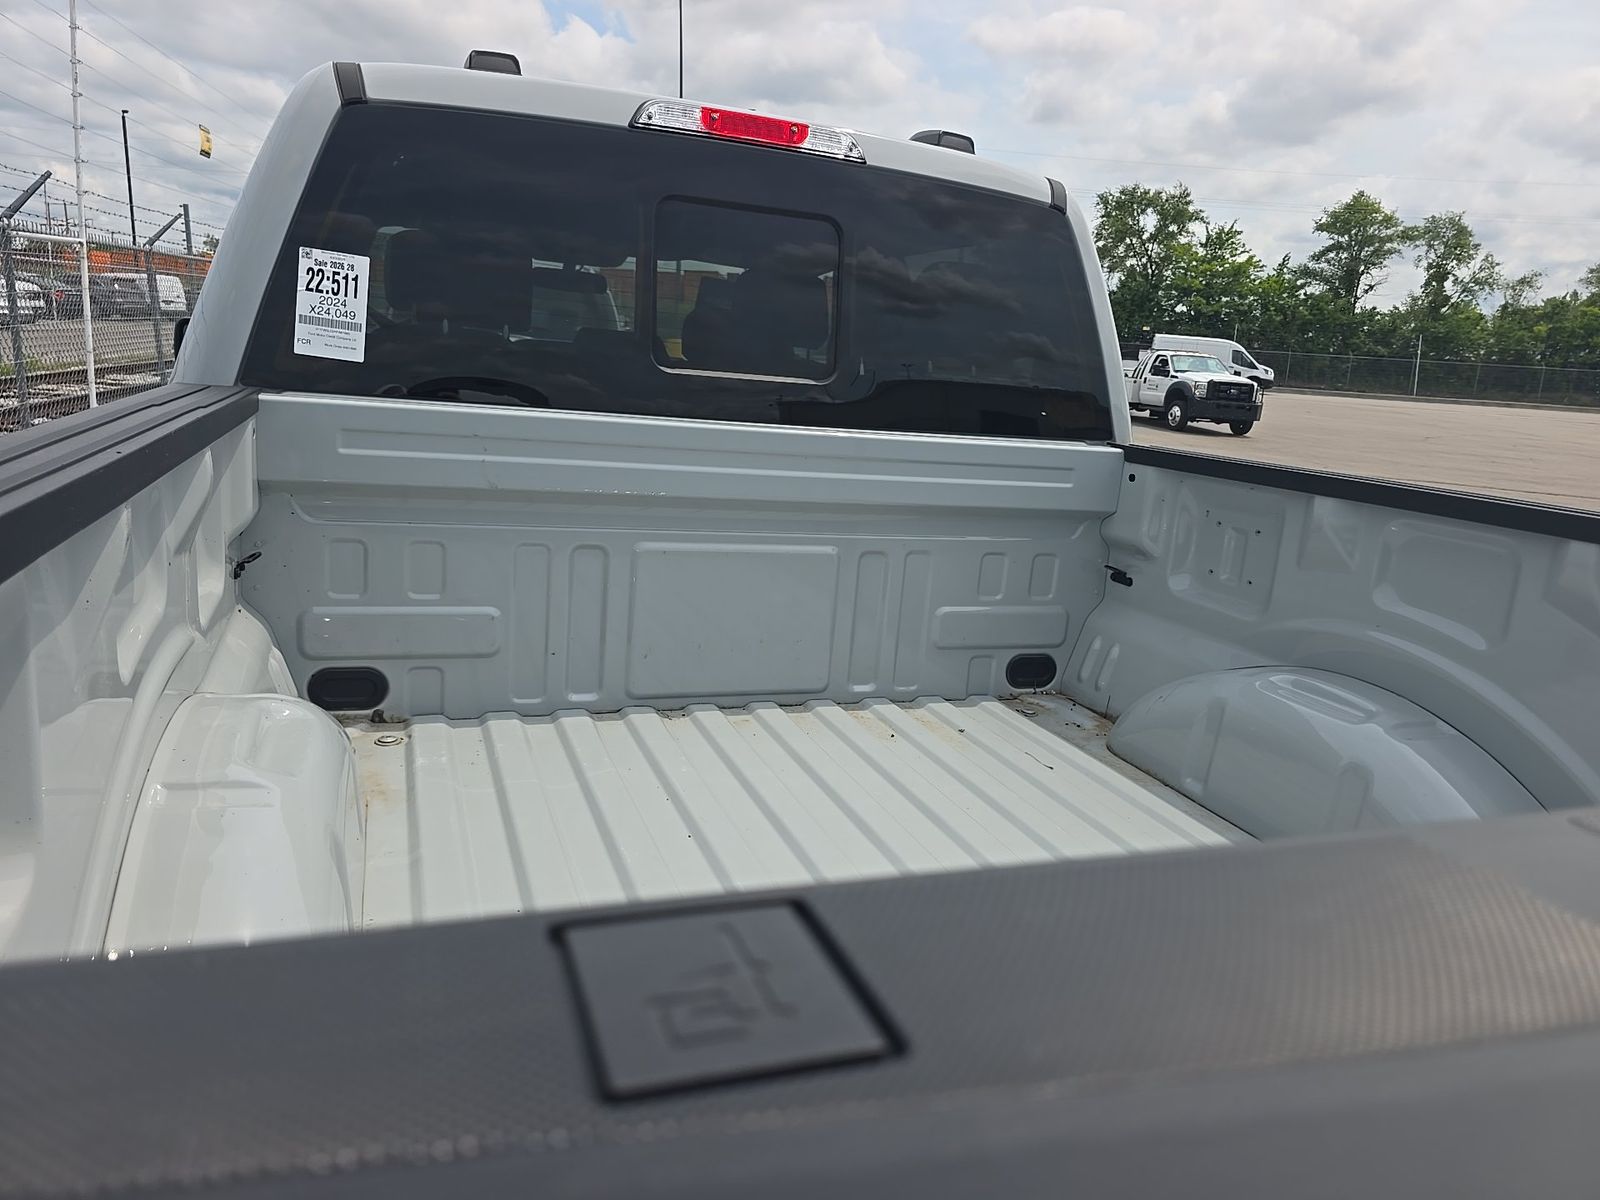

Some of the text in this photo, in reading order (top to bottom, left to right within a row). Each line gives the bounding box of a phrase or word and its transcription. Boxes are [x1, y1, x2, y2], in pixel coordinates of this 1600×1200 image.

[314, 258, 328, 268] Sale
[329, 261, 345, 271] 2026
[305, 266, 359, 299] 22:511
[319, 296, 347, 308] 2024
[309, 304, 356, 320] X24,049
[297, 337, 312, 345] FCR
